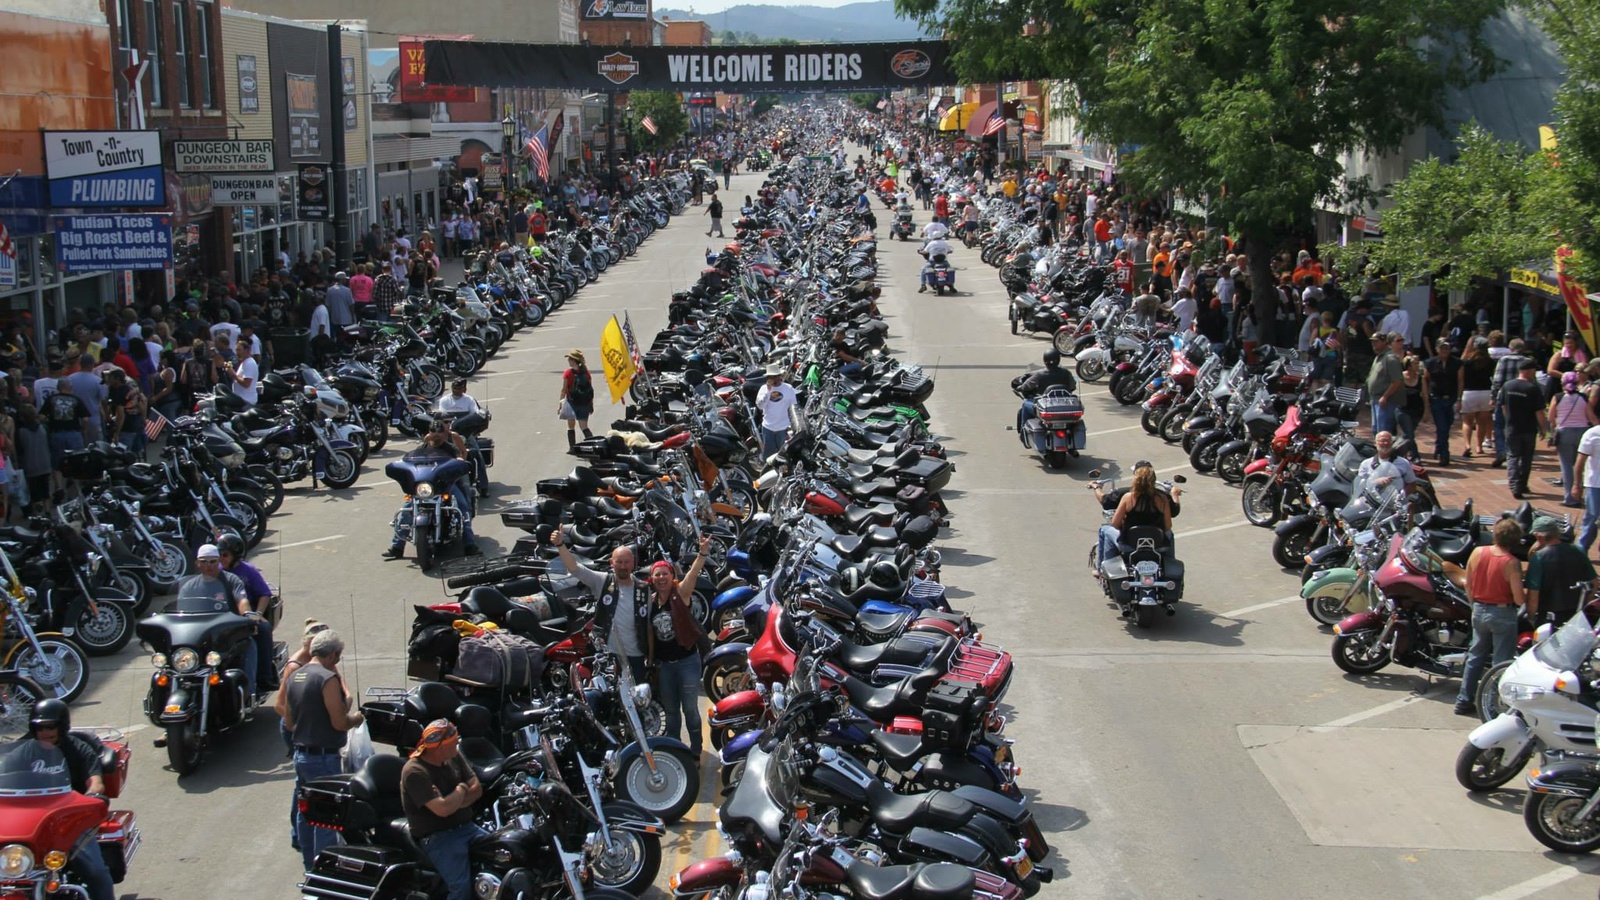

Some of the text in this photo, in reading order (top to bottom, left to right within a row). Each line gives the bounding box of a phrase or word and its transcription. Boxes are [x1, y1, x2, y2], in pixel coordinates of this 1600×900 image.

[668, 53, 862, 83] WELCOME RIDERS
[61, 139, 94, 156] Town
[177, 142, 271, 154] DUNGEON BAR
[97, 148, 144, 167] Country
[183, 154, 267, 165] DOWNSTAIRS
[72, 178, 155, 202] PLUMBING
[230, 190, 256, 200] OPEN
[72, 217, 153, 229] Indian Tacos
[61, 231, 167, 246] Big Roast Beef &
[63, 246, 167, 260] Pulled Pork Sandwiches
